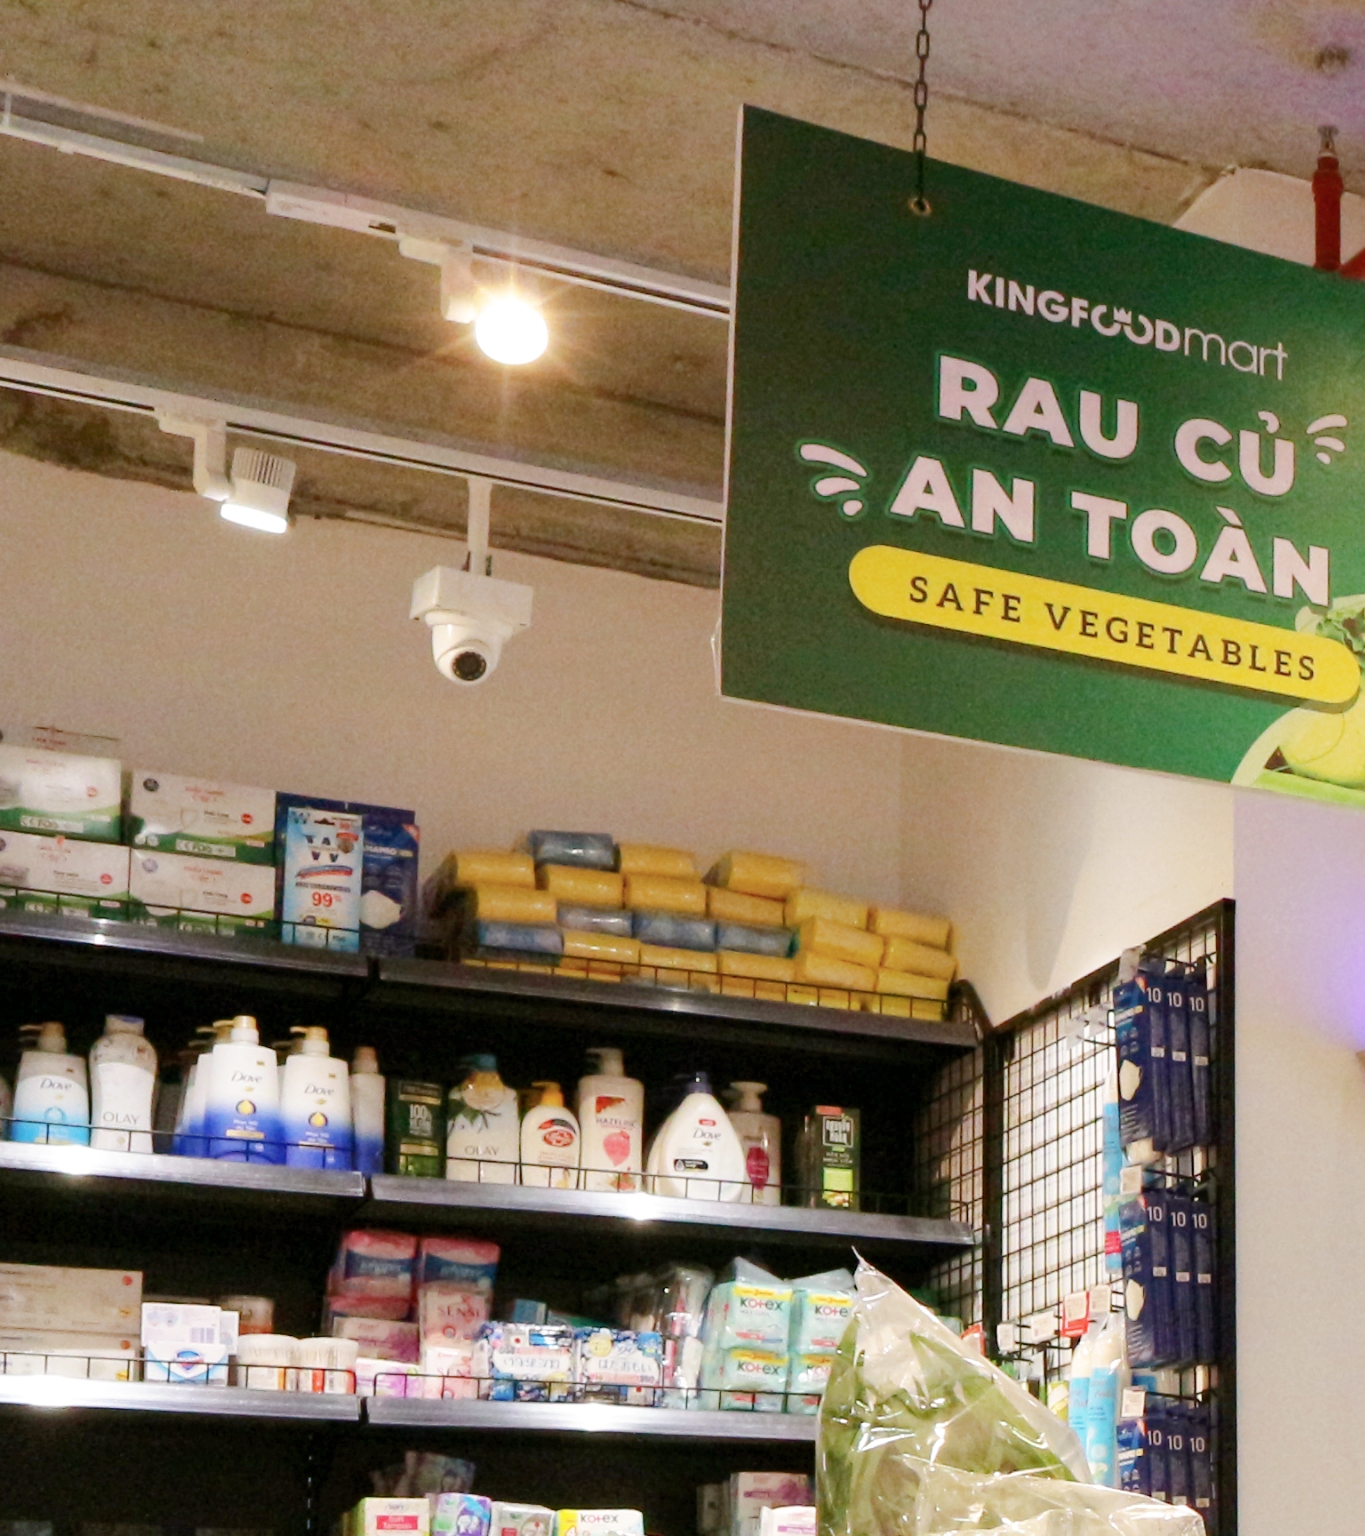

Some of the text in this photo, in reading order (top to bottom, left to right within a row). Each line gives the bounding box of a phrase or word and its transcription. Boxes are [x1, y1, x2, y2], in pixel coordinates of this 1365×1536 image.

[938, 355, 1295, 497] RAU CỦ
[890, 456, 1329, 607] AN TOÀN
[909, 575, 1316, 682] SAFE VEGETABLES
[312, 891, 333, 907] 99
[1147, 987, 1162, 1003] 10
[1167, 992, 1182, 1007] 10
[1189, 997, 1204, 1012] 10
[40, 1078, 72, 1091] Dove
[103, 1111, 140, 1125] OLAY
[693, 1128, 721, 1140] Dove
[1146, 1206, 1163, 1221] 10
[1171, 1212, 1186, 1227] 10
[1192, 1214, 1207, 1229] 10
[1147, 1430, 1161, 1446] 10
[1168, 1435, 1182, 1450] 10
[1190, 1438, 1204, 1451] 10
